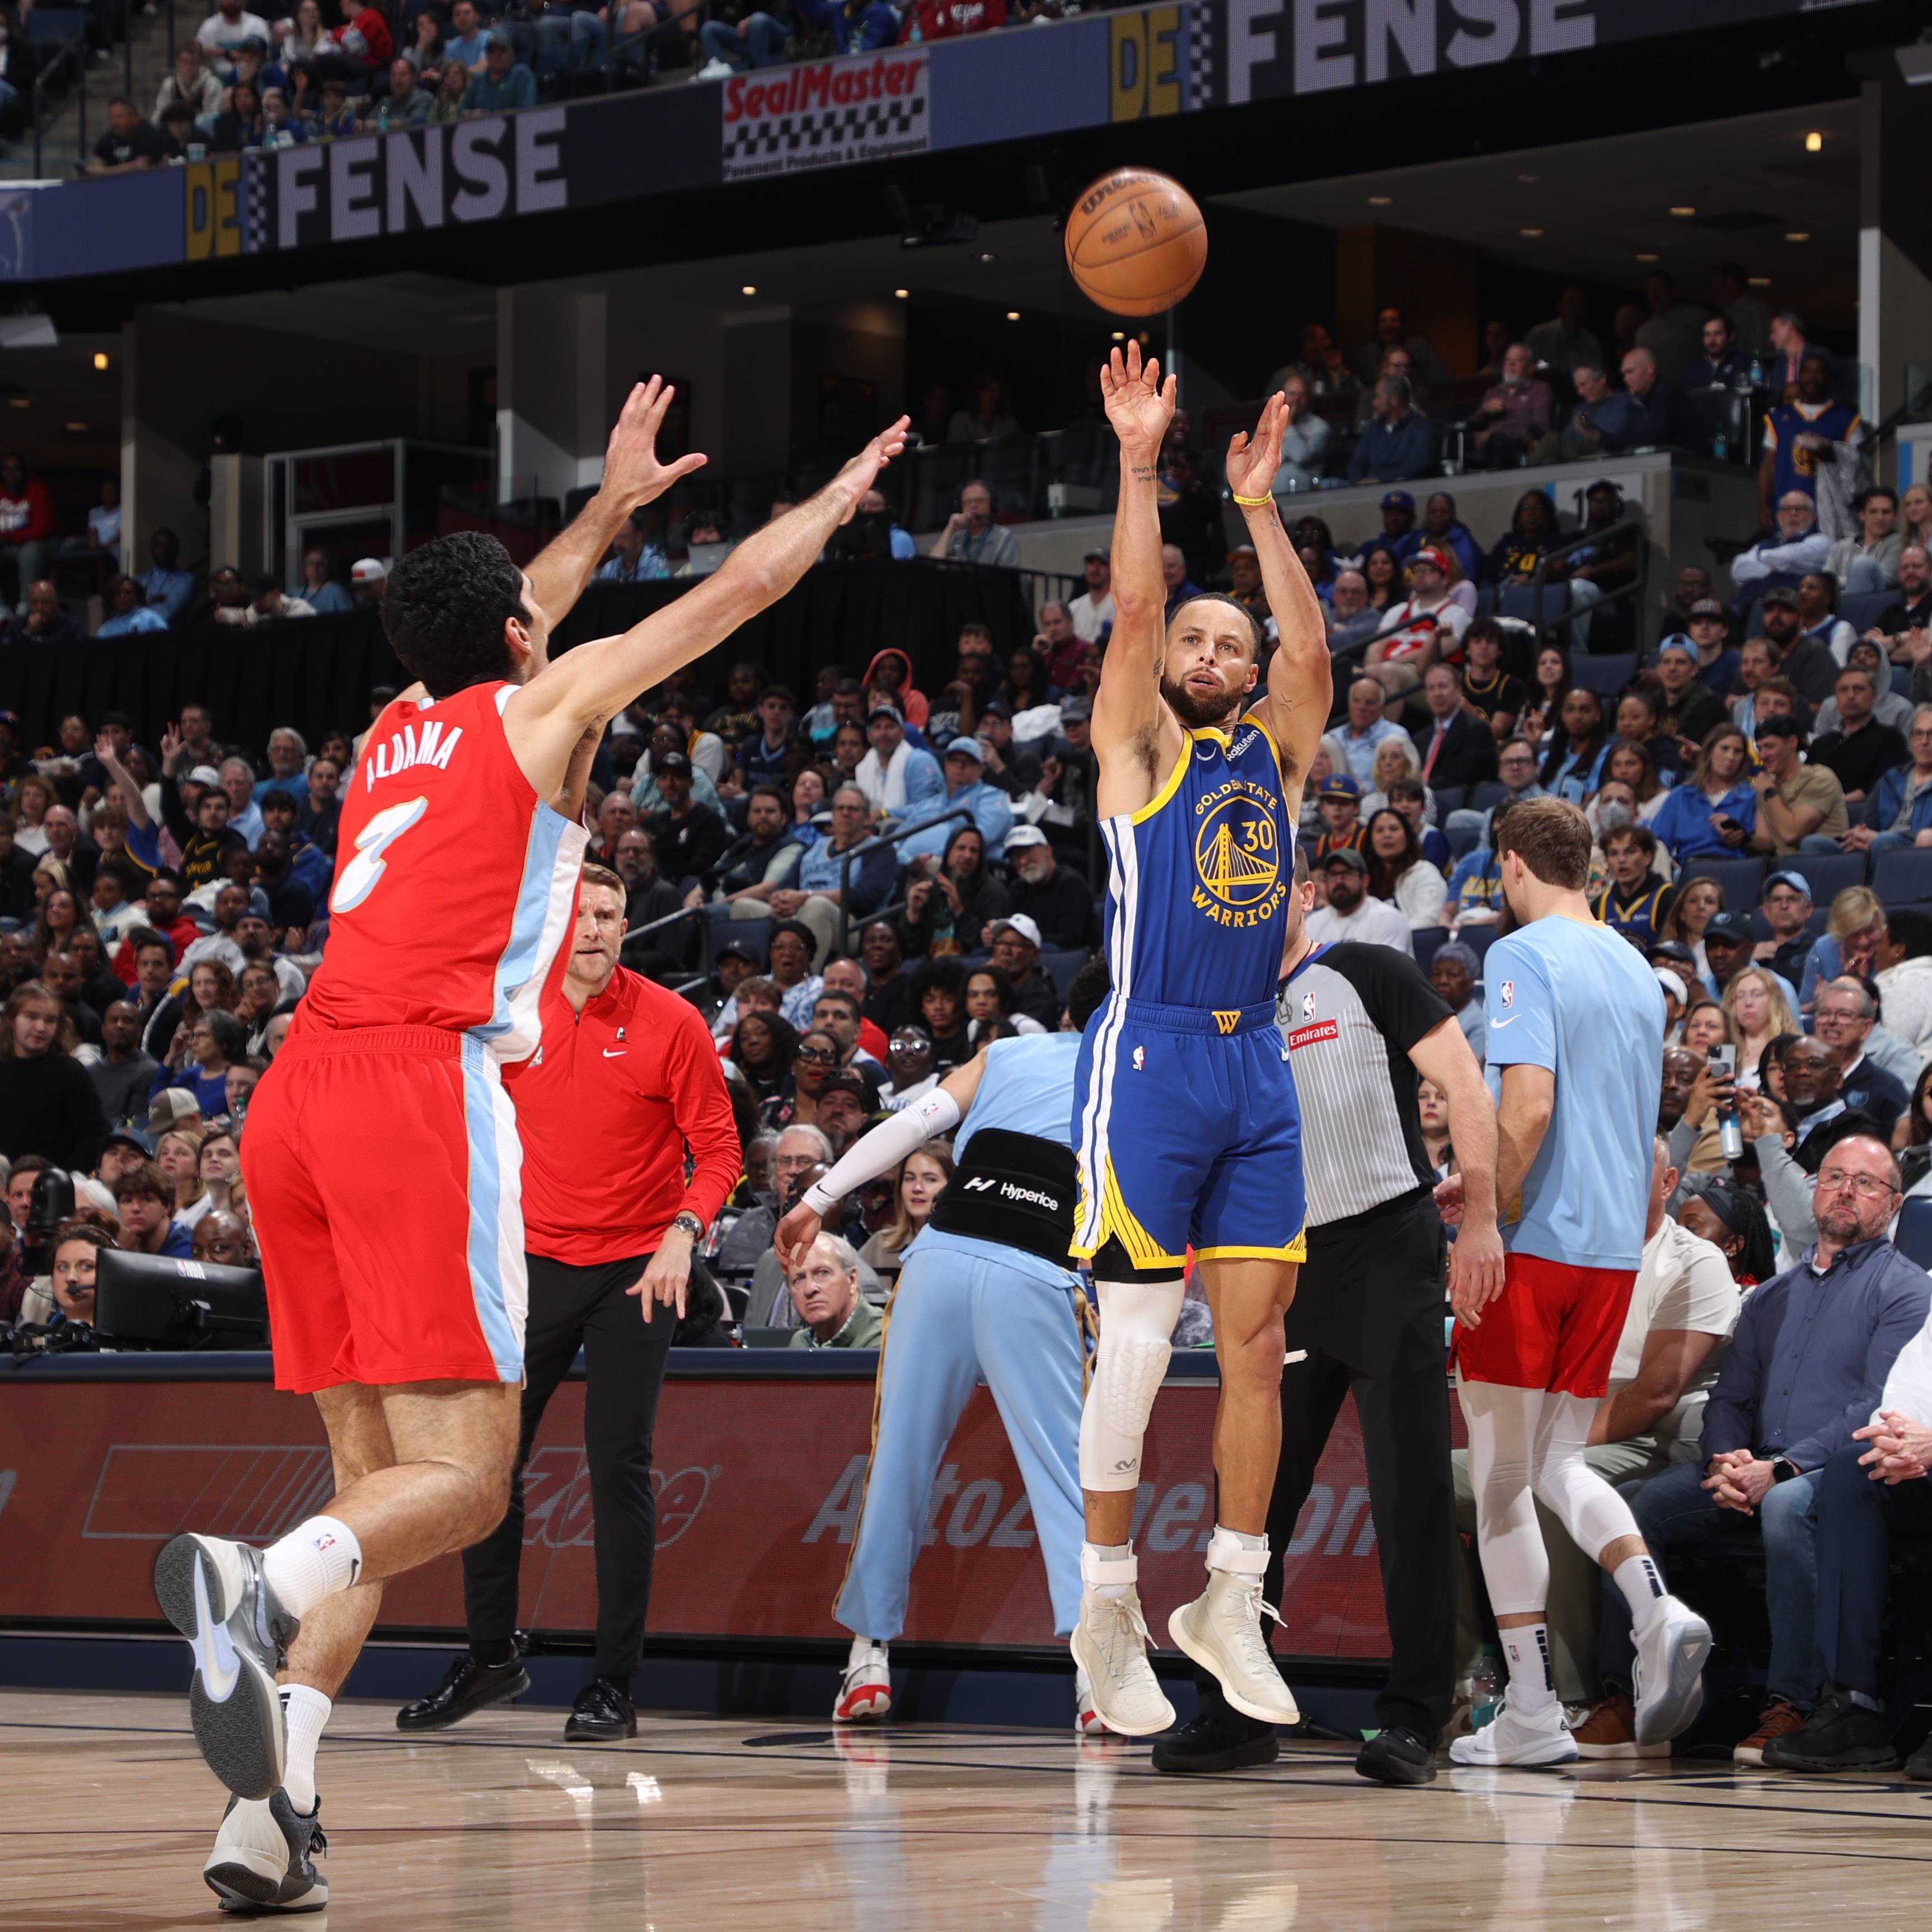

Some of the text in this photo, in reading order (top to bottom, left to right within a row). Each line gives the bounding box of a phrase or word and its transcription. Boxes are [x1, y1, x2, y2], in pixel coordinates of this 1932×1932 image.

[723, 57, 922, 123] SealMaster
[278, 107, 566, 248] FENSE
[367, 721, 463, 793] ALDAMA
[1226, 729, 1260, 761] Rakuten
[1241, 819, 1273, 852] 30
[1191, 881, 1286, 927] WARRIORS
[1289, 1024, 1337, 1046] Emirates
[1000, 1182, 1058, 1211] Hyperice
